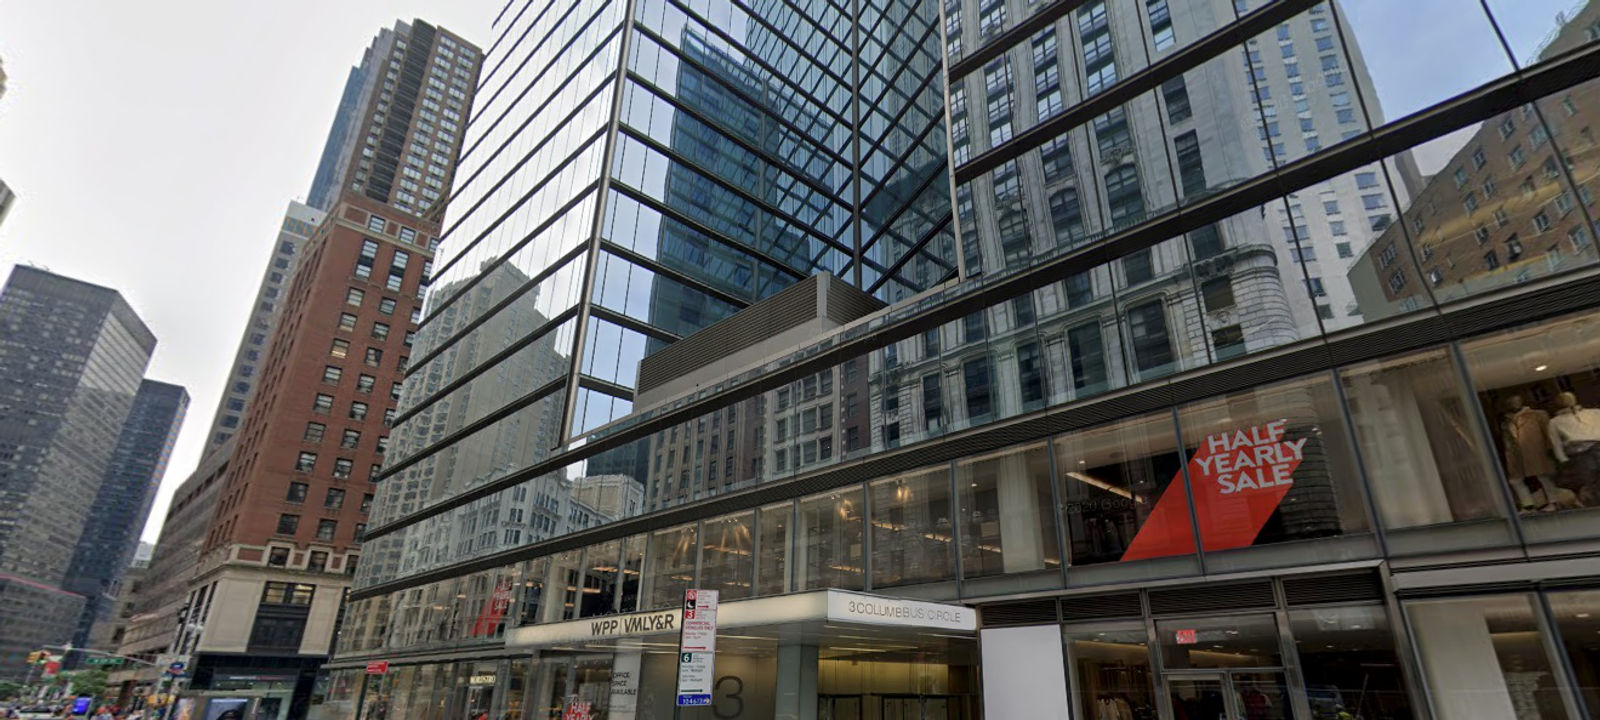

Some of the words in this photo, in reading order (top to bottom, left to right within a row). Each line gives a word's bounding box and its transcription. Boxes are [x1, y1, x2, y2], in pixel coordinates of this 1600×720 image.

[1208, 419, 1287, 454] HALF
[1195, 437, 1307, 476] YEARLY
[1217, 464, 1294, 494] SALE
[591, 620, 618, 636] WPP
[624, 614, 674, 633] VMLY&R
[713, 675, 744, 720] 3
